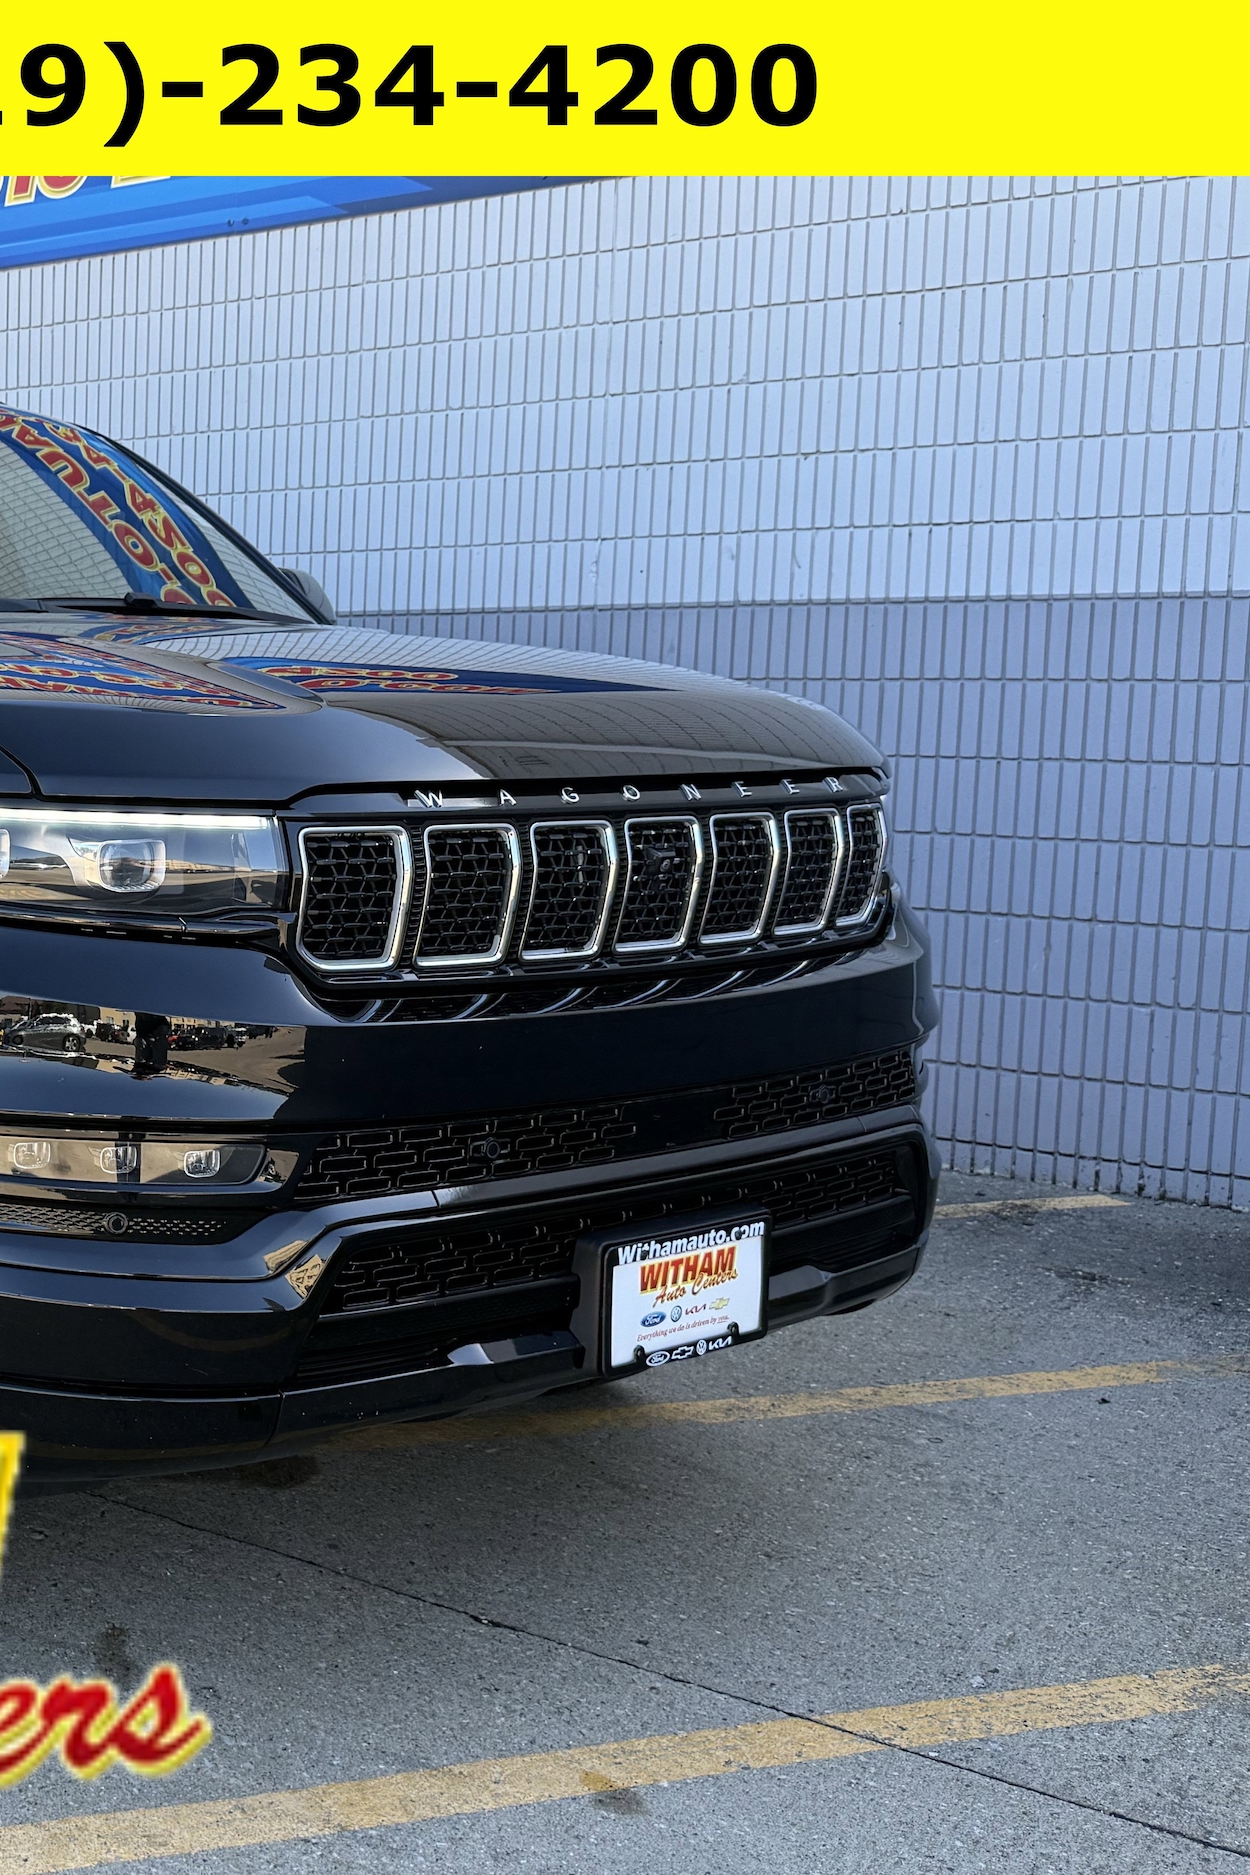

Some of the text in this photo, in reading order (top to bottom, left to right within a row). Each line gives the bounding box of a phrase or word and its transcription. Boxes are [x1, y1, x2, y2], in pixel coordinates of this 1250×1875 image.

[414, 776, 843, 808] WAGONEER
[640, 1245, 738, 1293] WITHAM
[653, 1268, 739, 1308] Auto Centers
[637, 1328, 668, 1342] Everything
[668, 1326, 677, 1334] we
[677, 1323, 685, 1331] do
[685, 1322, 691, 1330] is
[691, 1318, 709, 1329] driven
[710, 1316, 717, 1325] by
